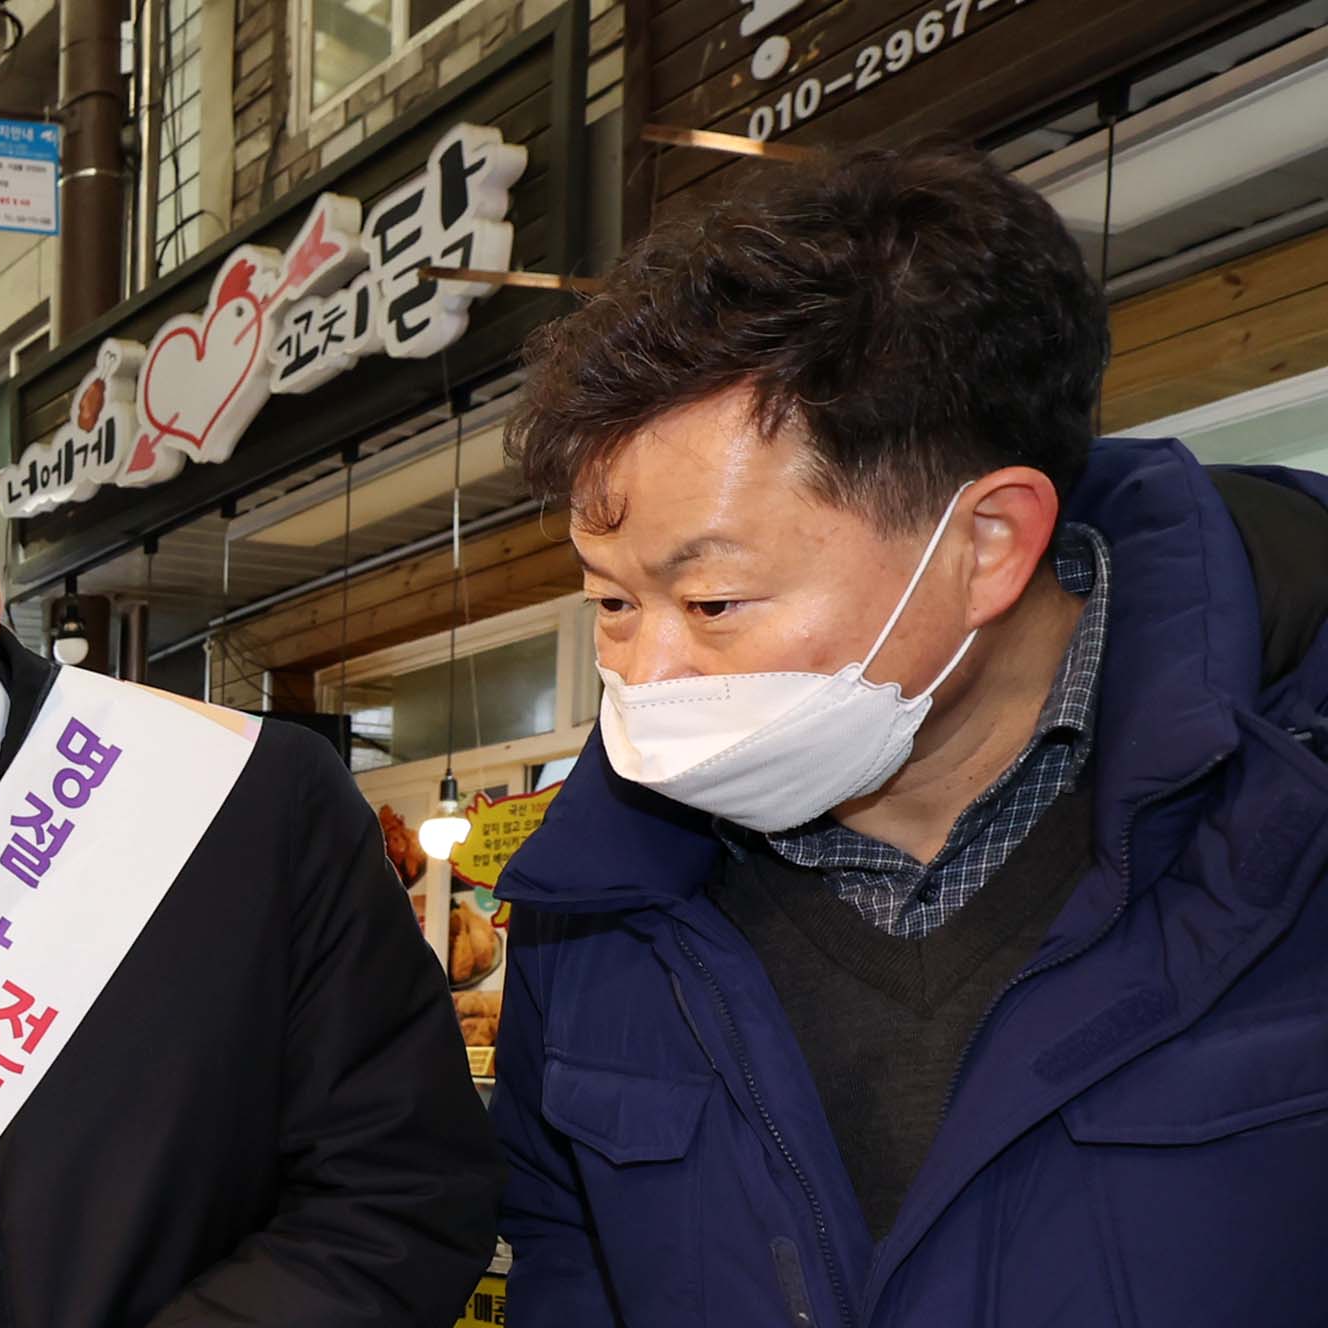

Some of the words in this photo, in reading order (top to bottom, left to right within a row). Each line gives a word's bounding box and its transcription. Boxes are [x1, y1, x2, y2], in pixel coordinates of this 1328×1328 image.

[748, 0, 1032, 142] 010-2967-
[7, 416, 116, 504] 너에게
[0, 717, 122, 889] 명절
